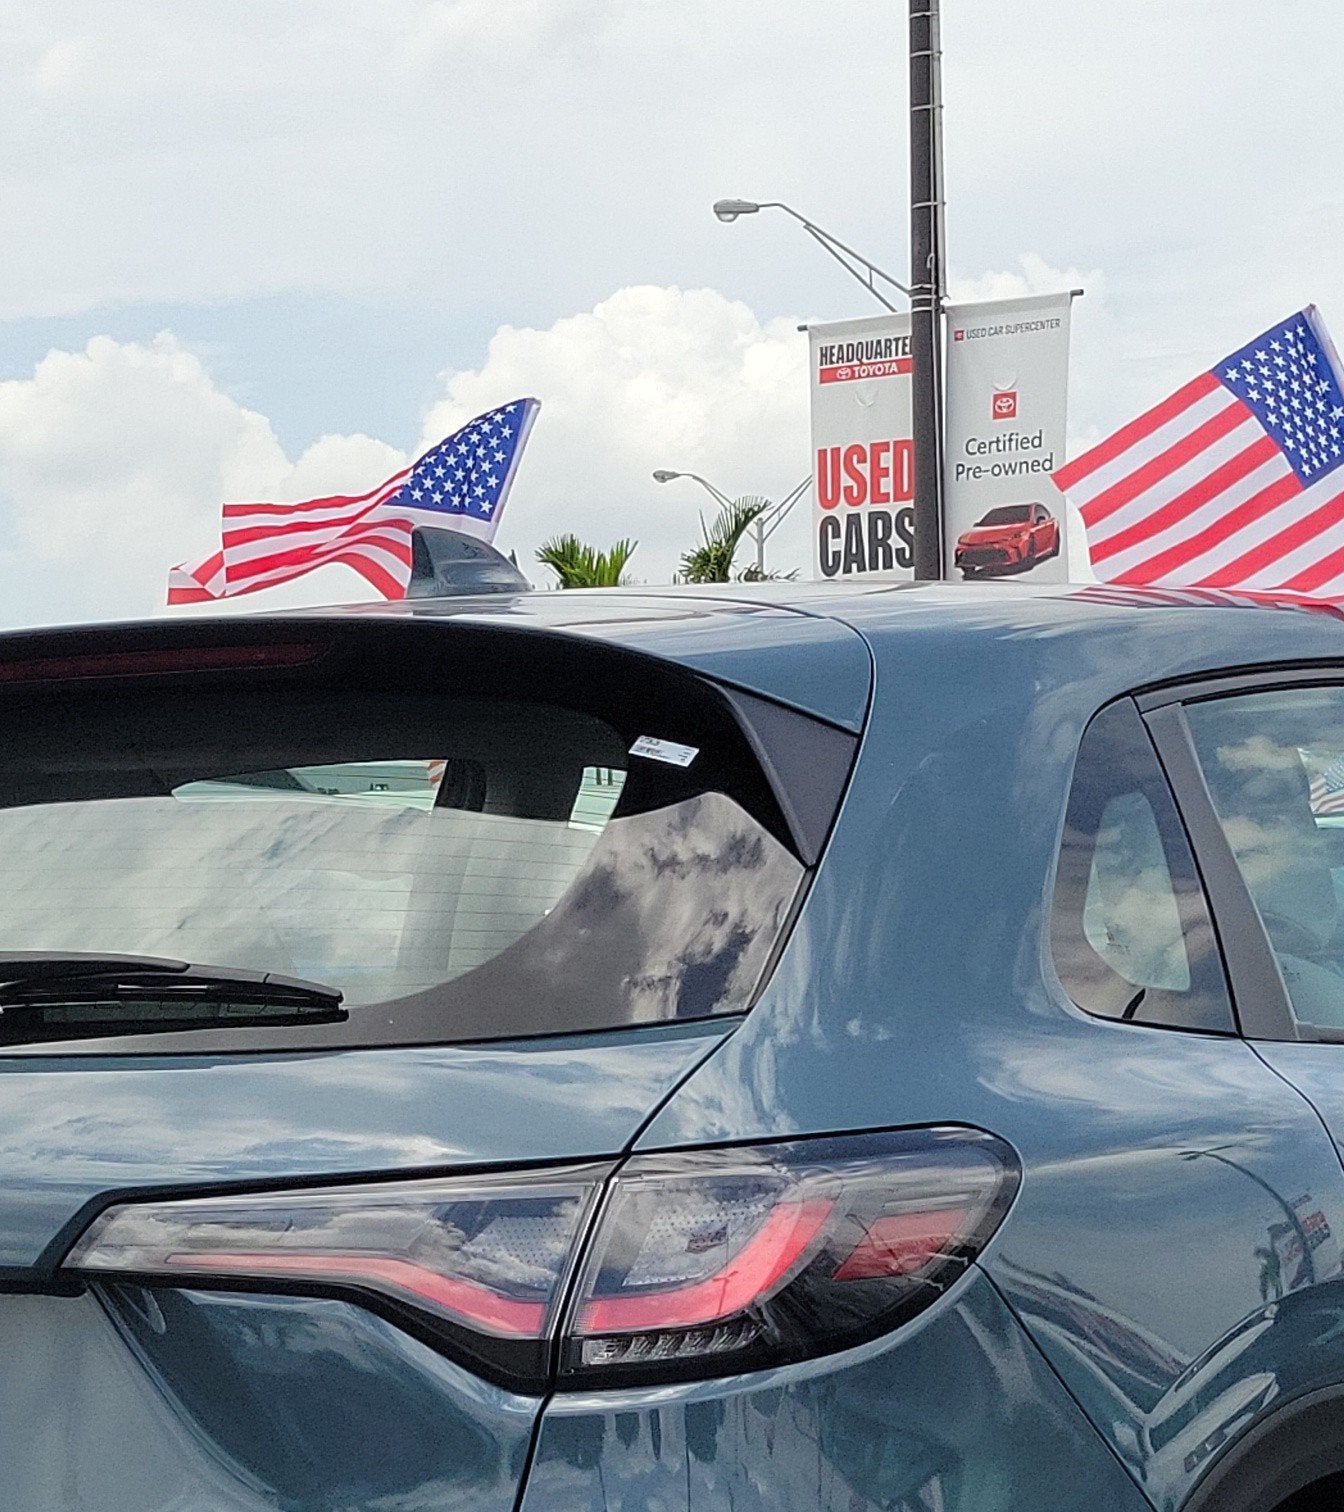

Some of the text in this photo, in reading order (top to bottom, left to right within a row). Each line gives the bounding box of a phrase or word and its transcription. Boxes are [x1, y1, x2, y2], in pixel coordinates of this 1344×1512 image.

[966, 318, 1061, 340] USED CAR SUPERCENTER
[819, 335, 912, 366] HEADQUARTE
[852, 363, 899, 378] TOYOTA
[964, 429, 1043, 456] Certified
[817, 439, 915, 510] USED
[955, 452, 1054, 482] Pre-owned
[819, 507, 915, 578] CARS
